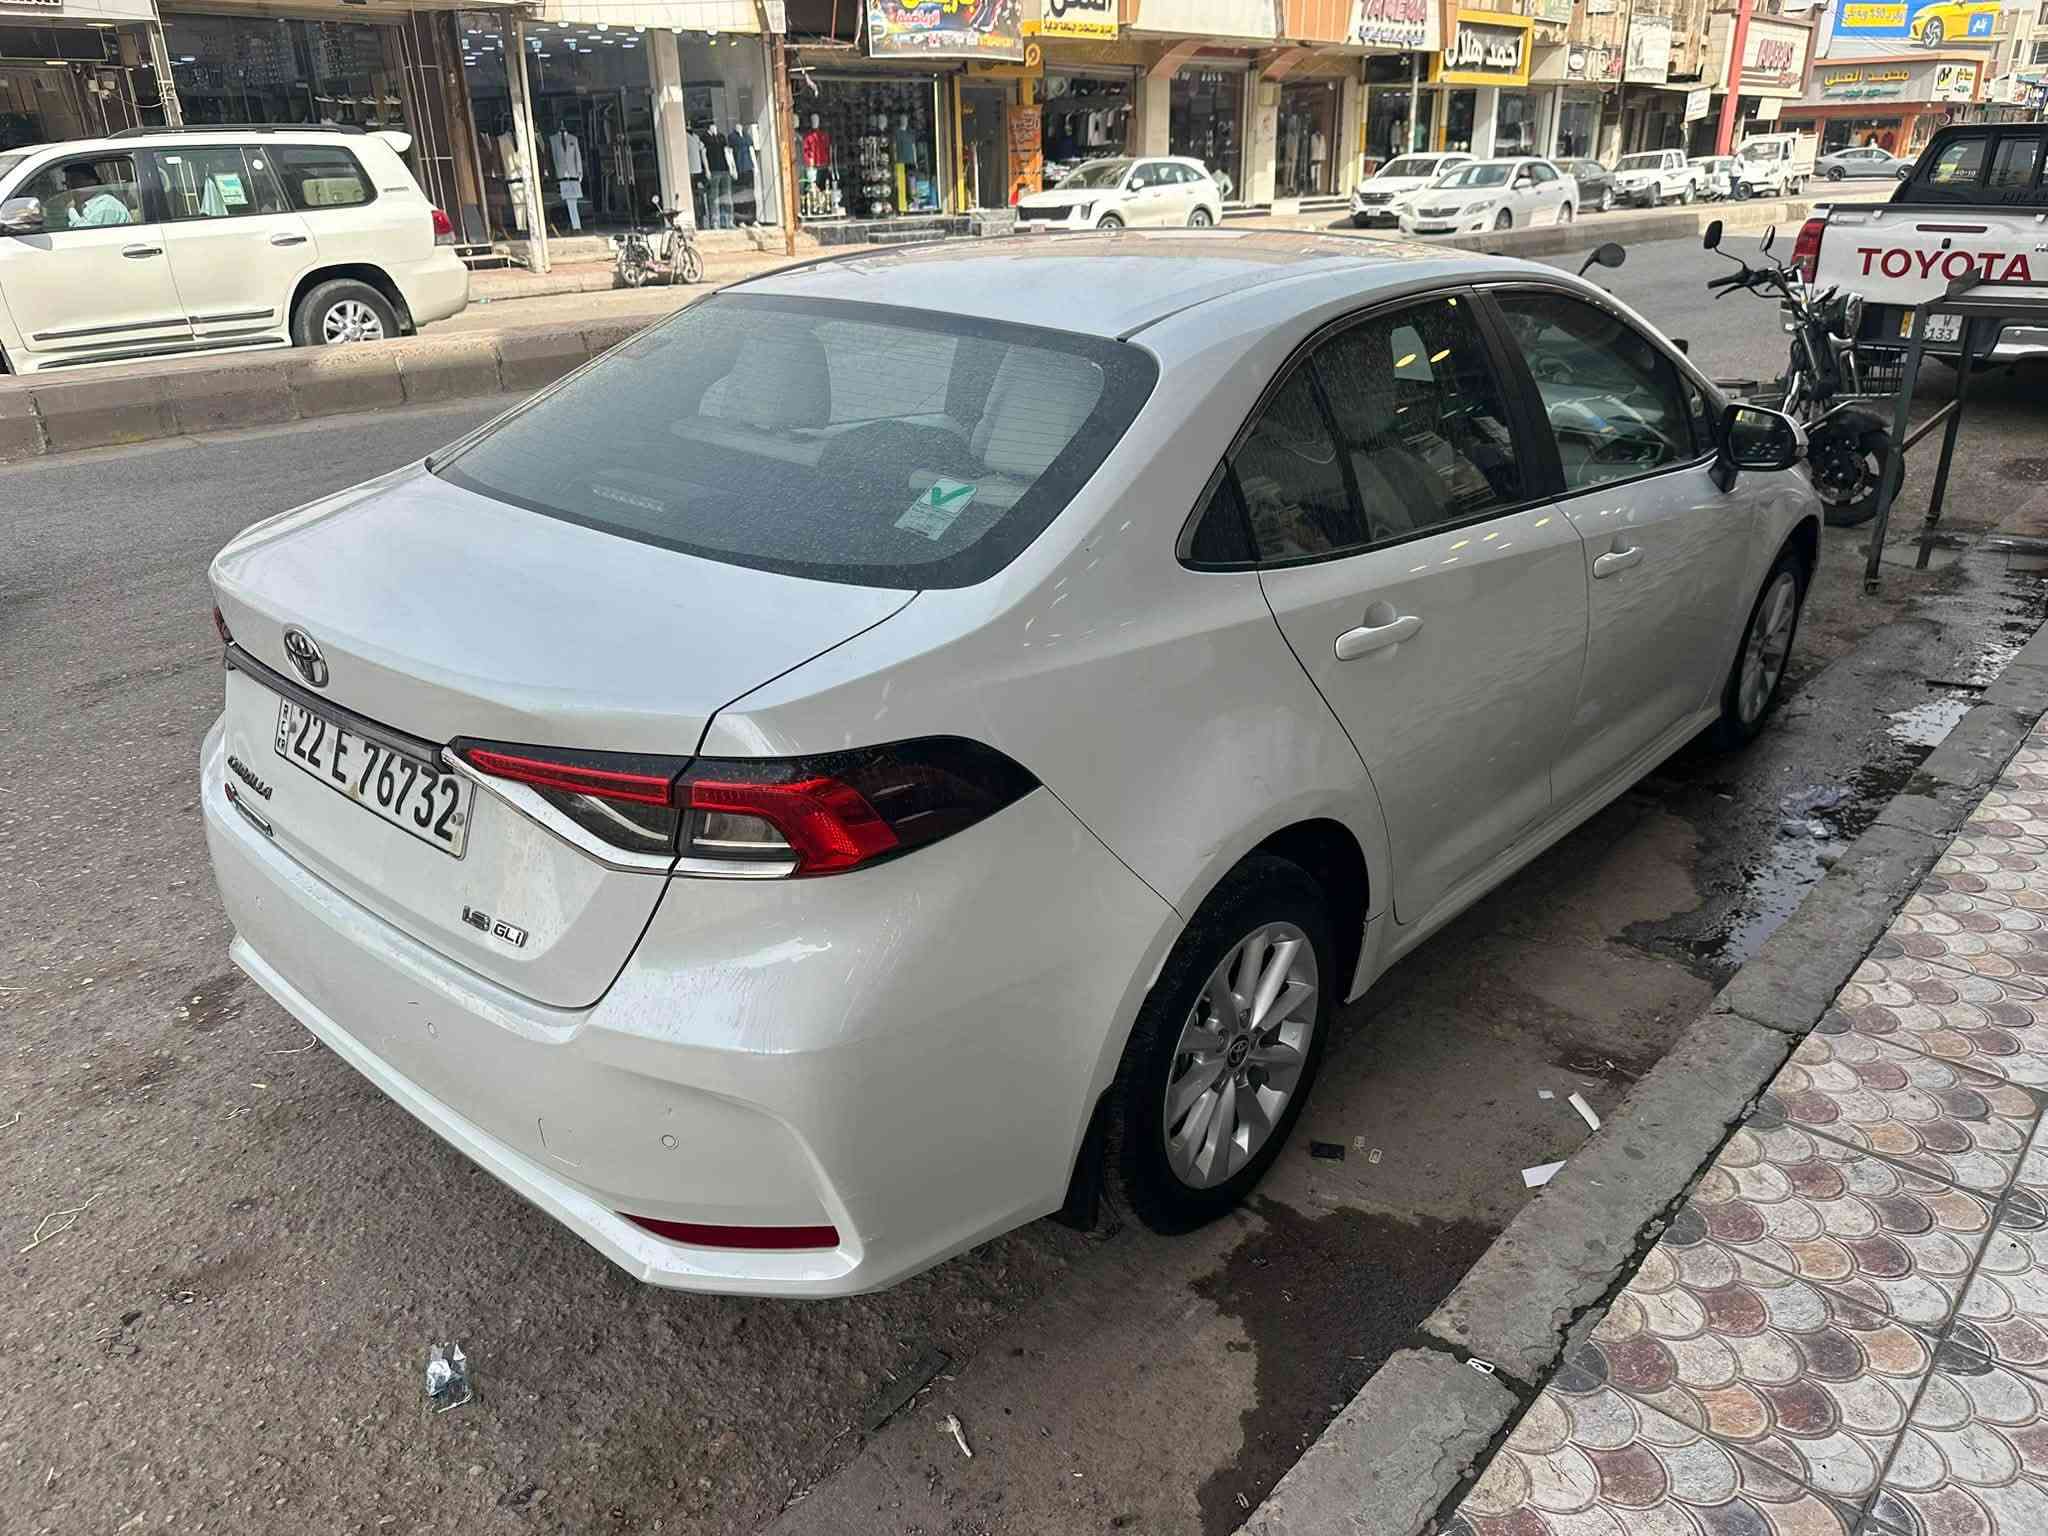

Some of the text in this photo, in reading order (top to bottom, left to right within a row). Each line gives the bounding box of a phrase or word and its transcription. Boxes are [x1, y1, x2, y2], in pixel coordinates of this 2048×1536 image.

[1445, 21, 1483, 67] هلال
[1486, 35, 1523, 68] احمد
[1867, 68, 1910, 82] محمد
[1857, 247, 2033, 282] TOYOTA
[294, 708, 326, 768] 22
[331, 727, 352, 785] E
[358, 742, 461, 842] 76732
[493, 922, 522, 945] GLI
